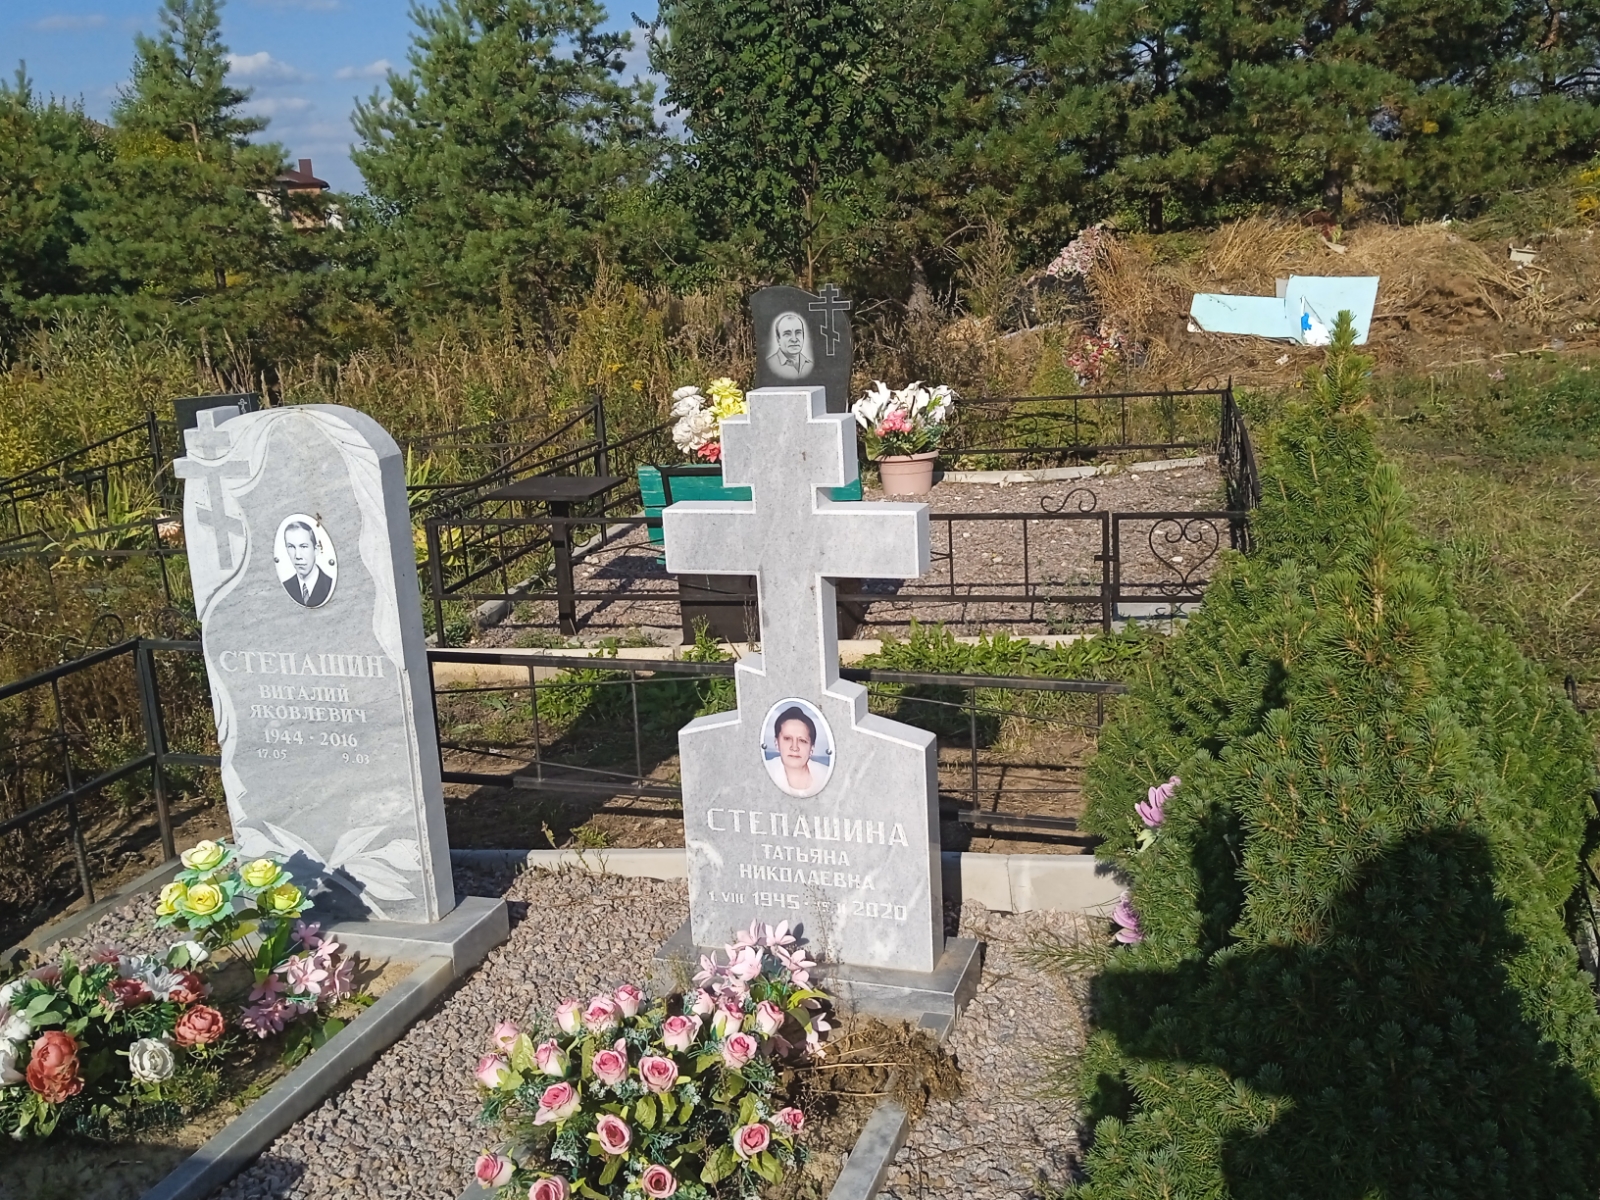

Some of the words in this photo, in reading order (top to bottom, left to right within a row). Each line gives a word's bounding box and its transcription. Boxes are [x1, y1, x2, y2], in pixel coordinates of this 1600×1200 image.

[218, 650, 385, 678] СТЕПАШИН
[259, 684, 351, 702] ВИТАЛИЙ
[250, 705, 367, 723] ЯКОВЛЕВИЧ
[265, 729, 304, 745] 1944
[320, 732, 358, 747] 2016
[257, 748, 288, 760] 17.05
[342, 752, 370, 765] 9.03
[707, 808, 909, 847] СТЕПАШИНА
[761, 843, 850, 866] ТАТЬЯНА
[739, 863, 875, 890] НИКОЛАЕВНА
[752, 891, 800, 910] 1945
[852, 900, 908, 921] 2020
